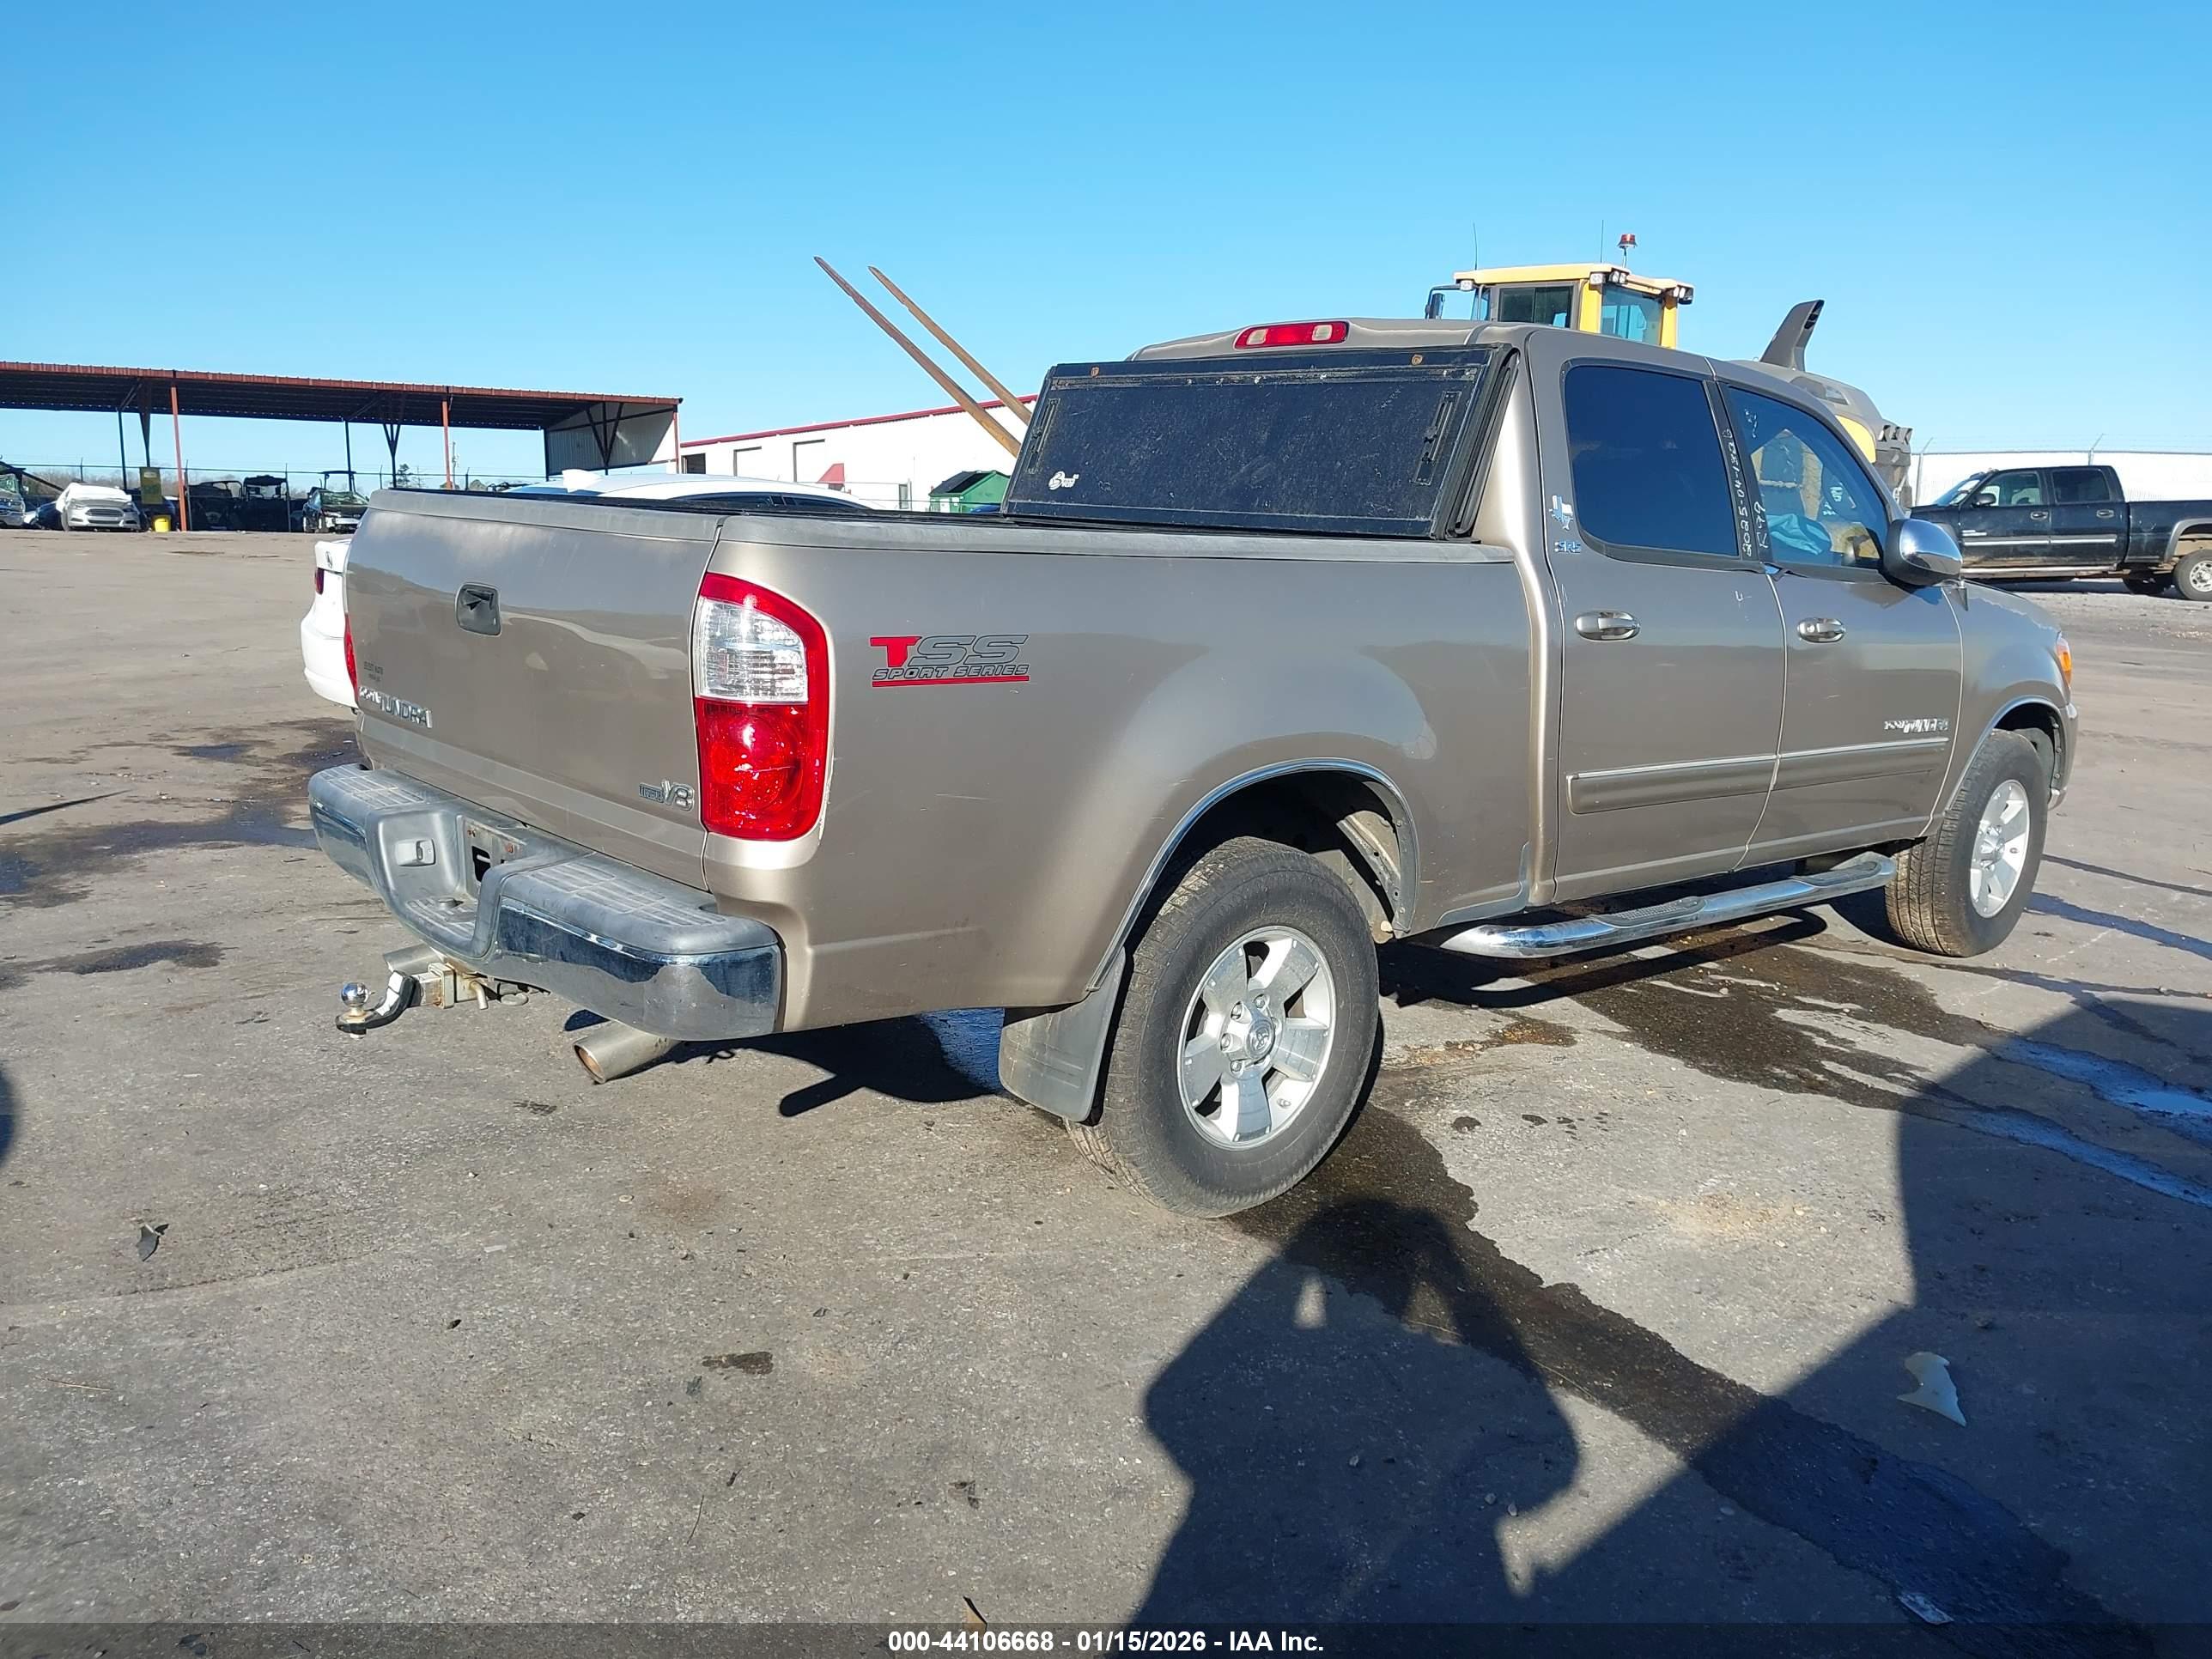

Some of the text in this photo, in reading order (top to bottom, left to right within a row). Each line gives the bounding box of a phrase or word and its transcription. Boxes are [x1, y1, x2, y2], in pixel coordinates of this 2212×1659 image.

[870, 635, 1030, 668] TSS
[872, 665, 1030, 680] SPORT SERIES
[660, 778, 696, 811] V8
